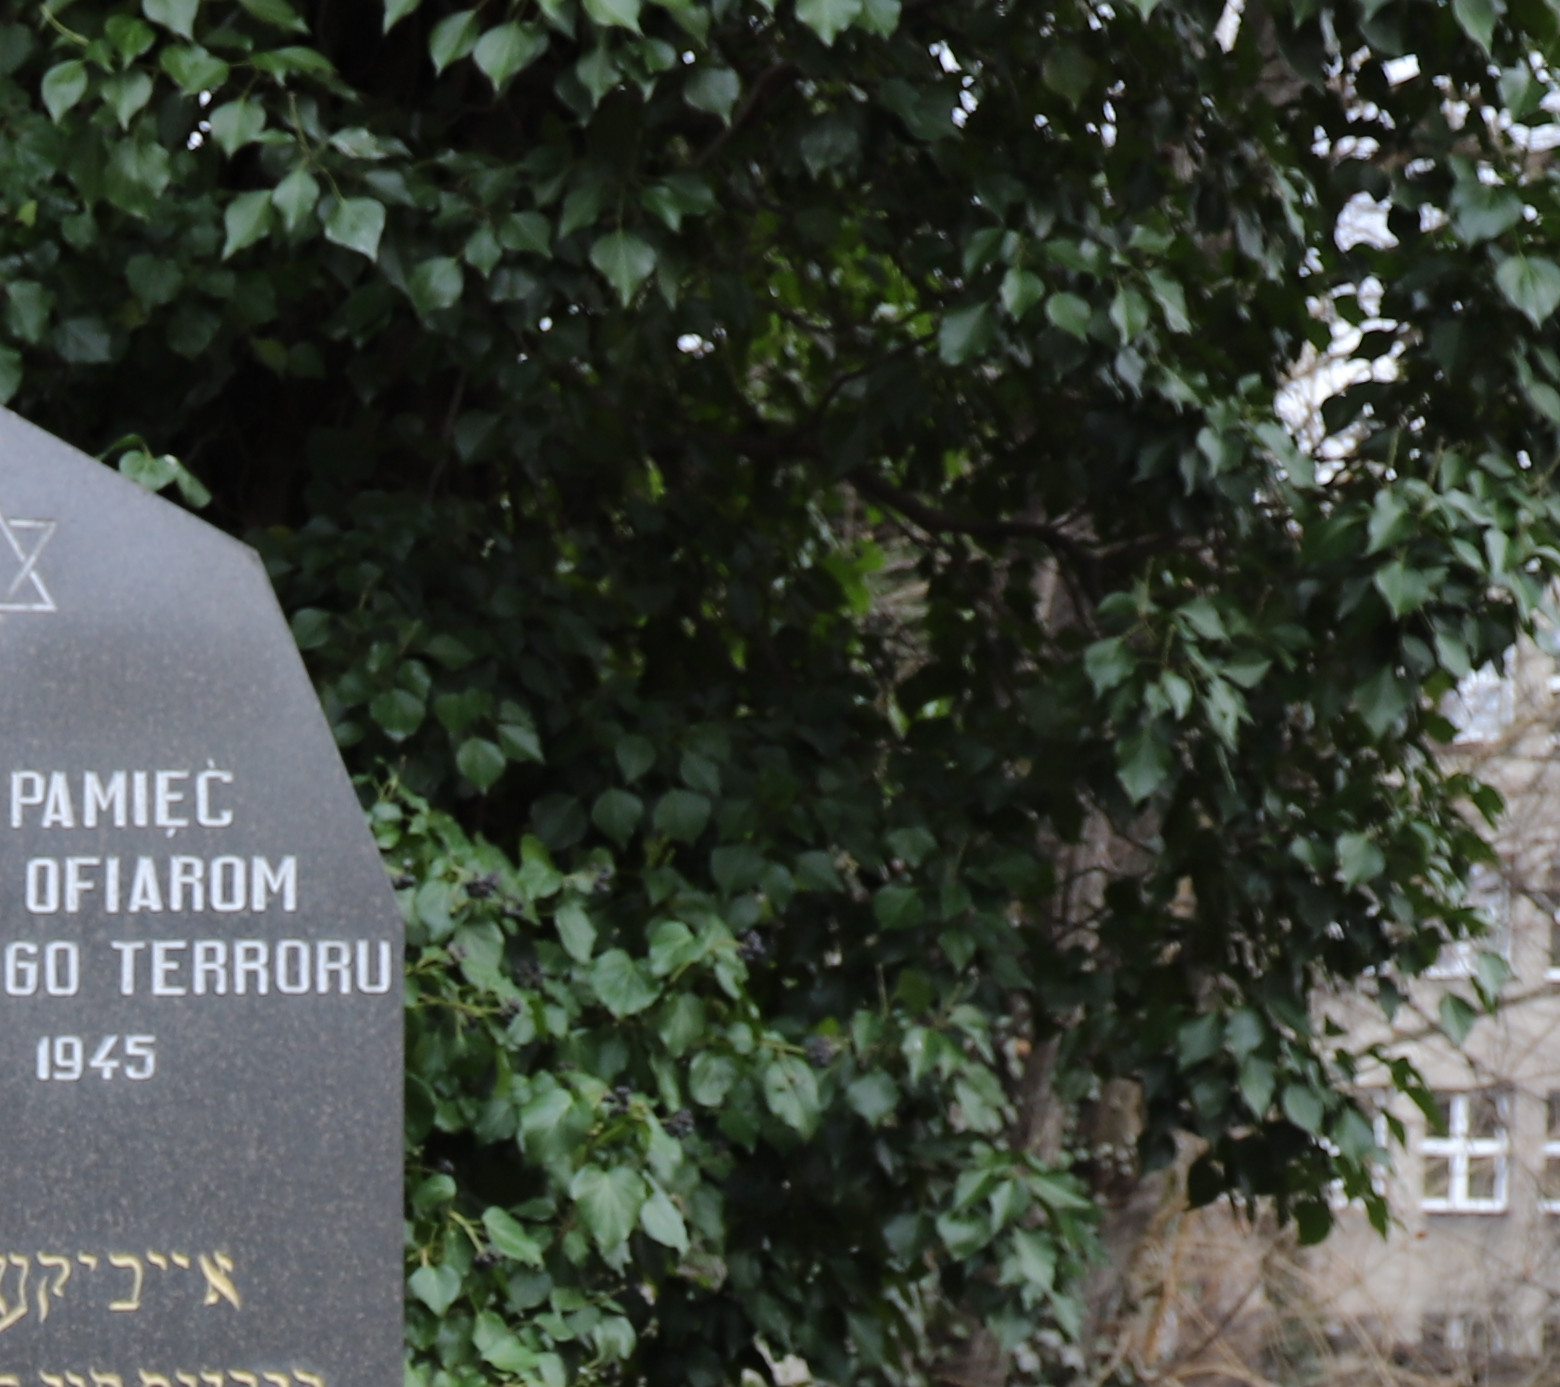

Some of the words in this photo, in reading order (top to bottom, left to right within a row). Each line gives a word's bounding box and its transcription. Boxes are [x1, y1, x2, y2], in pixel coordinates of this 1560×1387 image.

[10, 758, 235, 838] PAMIĘĆ
[25, 854, 299, 915] OFIAROM
[110, 939, 393, 997] TERRORU
[34, 1034, 157, 1082] 1945
